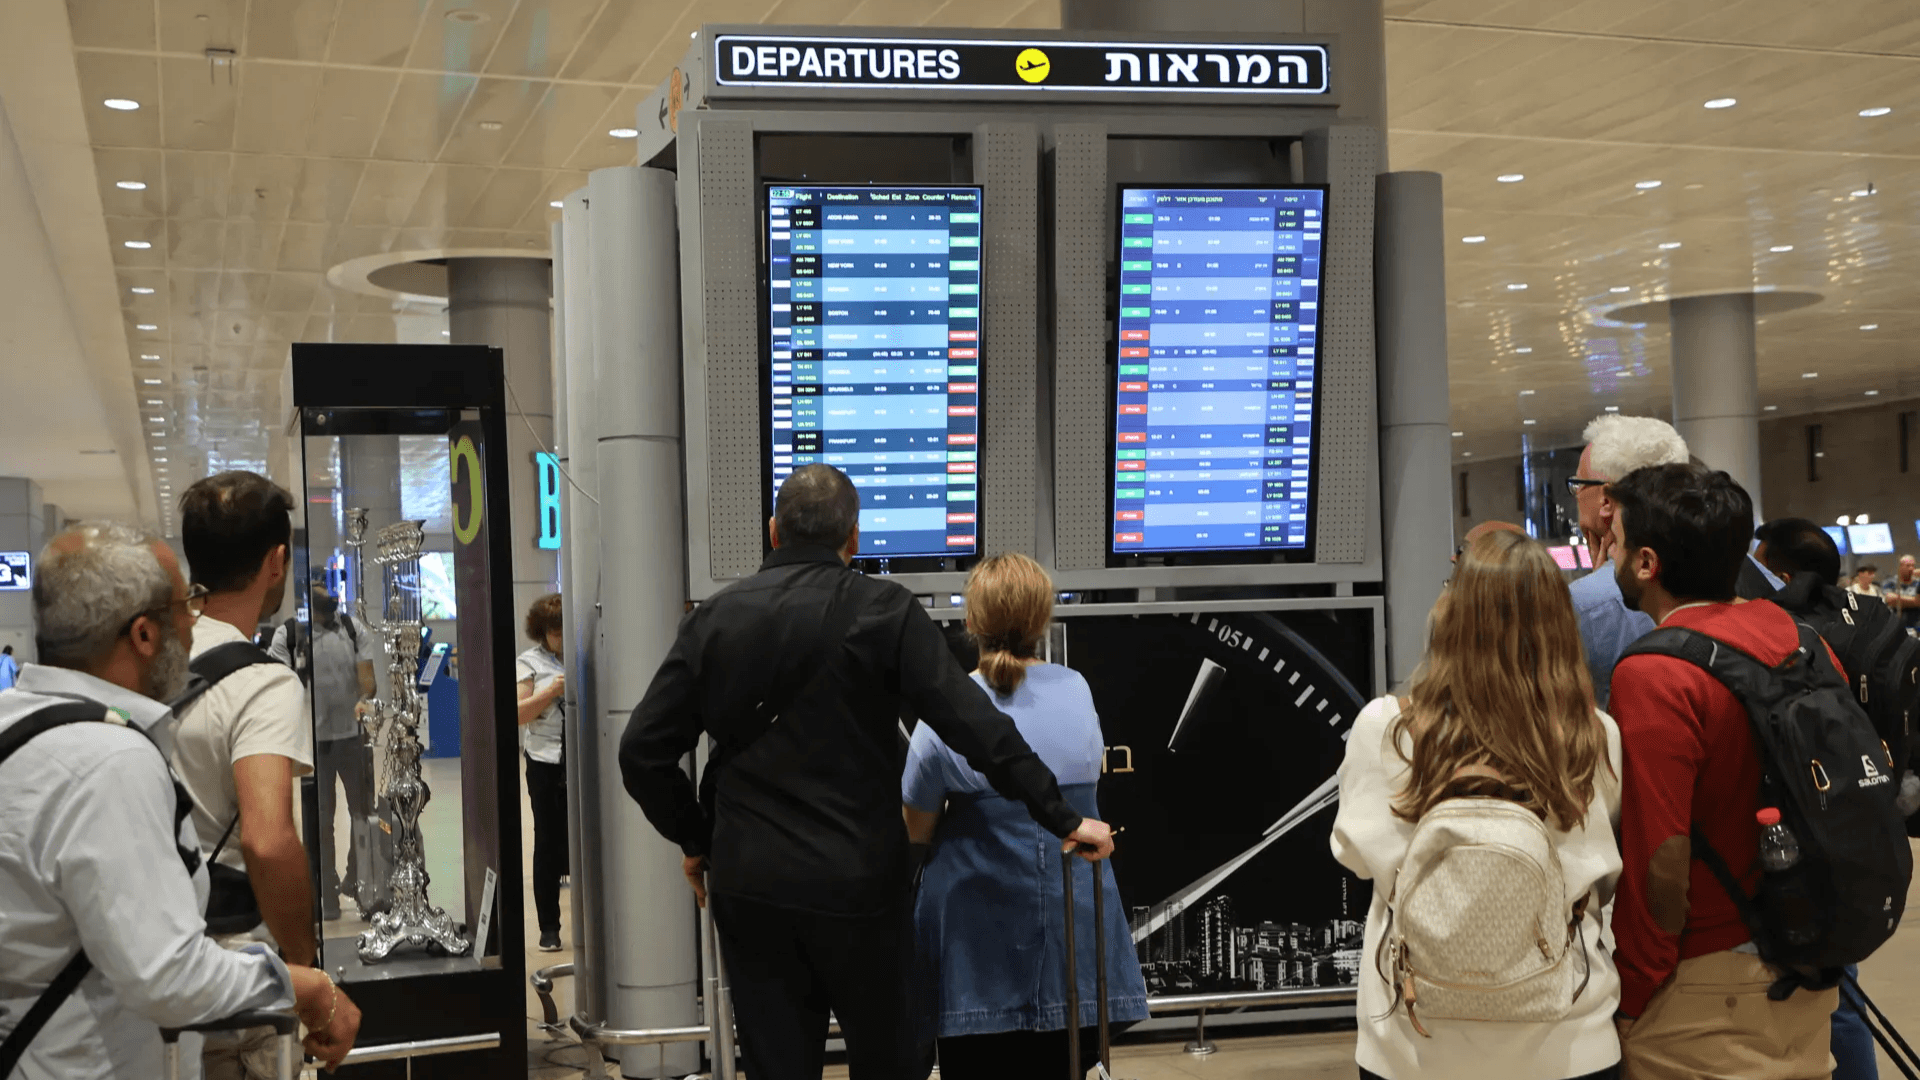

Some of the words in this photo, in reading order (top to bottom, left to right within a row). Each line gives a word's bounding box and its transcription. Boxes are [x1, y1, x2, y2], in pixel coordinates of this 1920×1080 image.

[731, 45, 960, 80] DEPARTURES
[1104, 51, 1309, 84] המראות
[536, 452, 561, 549] B
[1218, 624, 1244, 648] 05
